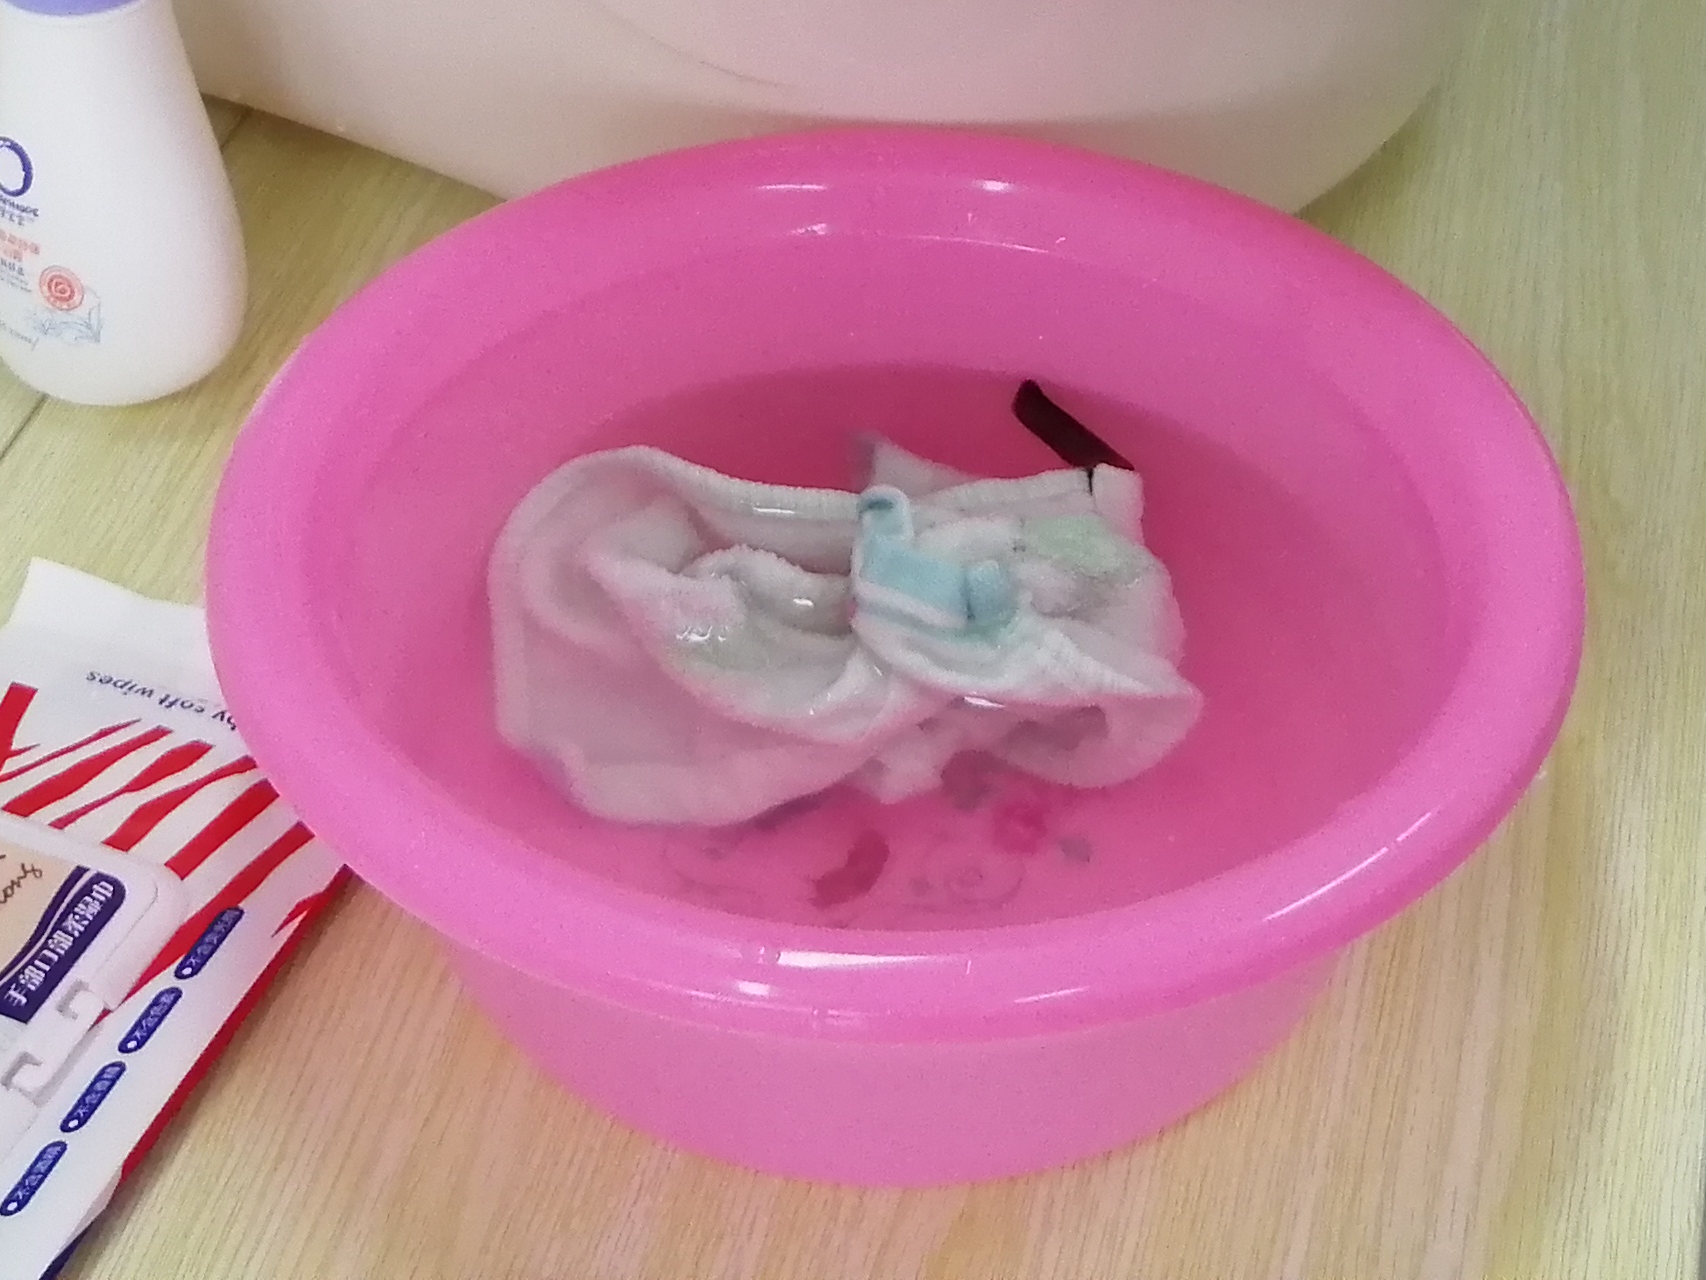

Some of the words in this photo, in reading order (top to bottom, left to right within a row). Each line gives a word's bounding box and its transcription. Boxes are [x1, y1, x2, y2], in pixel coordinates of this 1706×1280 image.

[85, 669, 154, 699] wipes
[3, 879, 115, 1008] 手部口部柔湿巾
